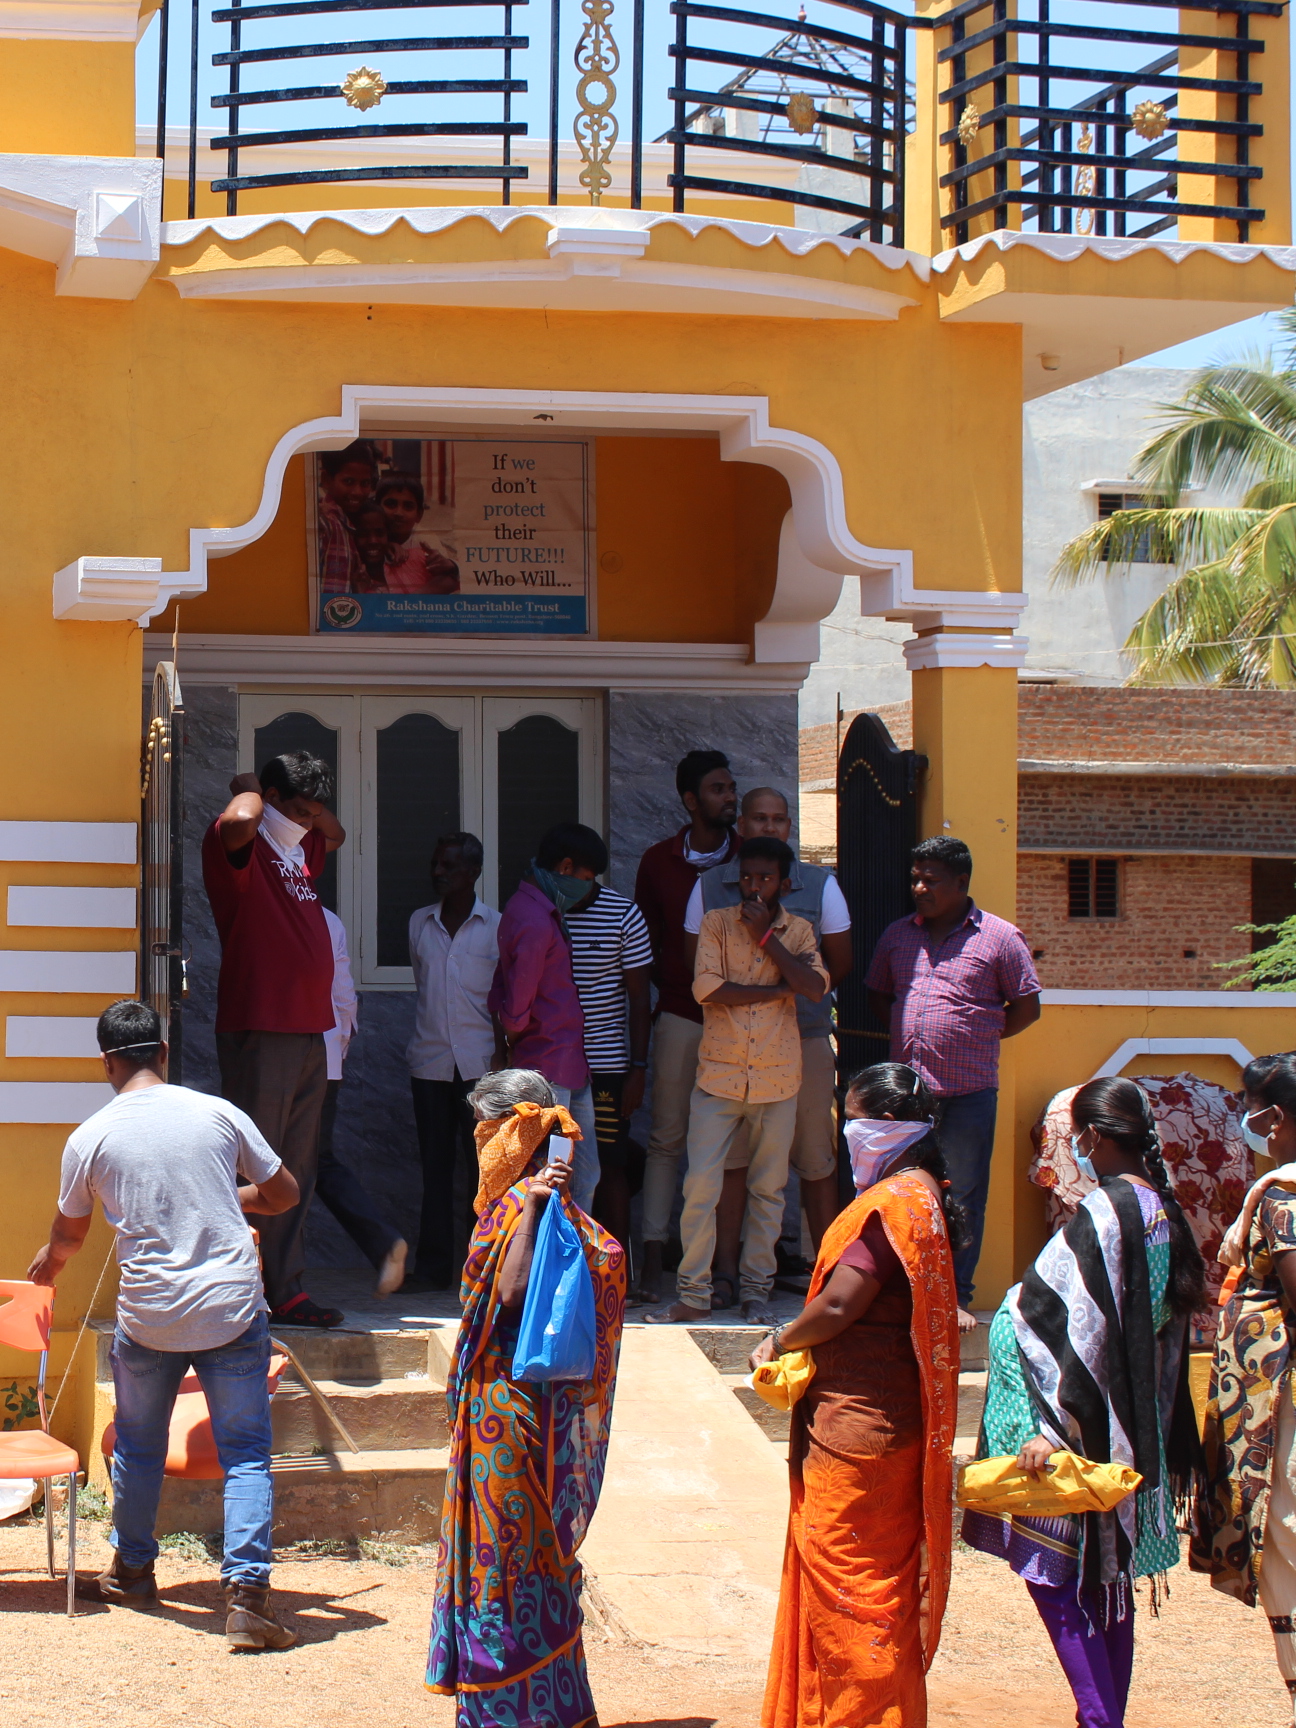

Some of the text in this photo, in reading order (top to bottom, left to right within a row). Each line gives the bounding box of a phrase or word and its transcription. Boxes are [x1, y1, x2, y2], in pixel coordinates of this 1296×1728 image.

[492, 454, 536, 471] If we
[483, 502, 546, 520] protect
[494, 524, 536, 540] their
[465, 547, 565, 564] FUTURE!!!
[473, 570, 572, 588] Who Will...
[387, 600, 559, 613] Rakshana Charitable Trust
